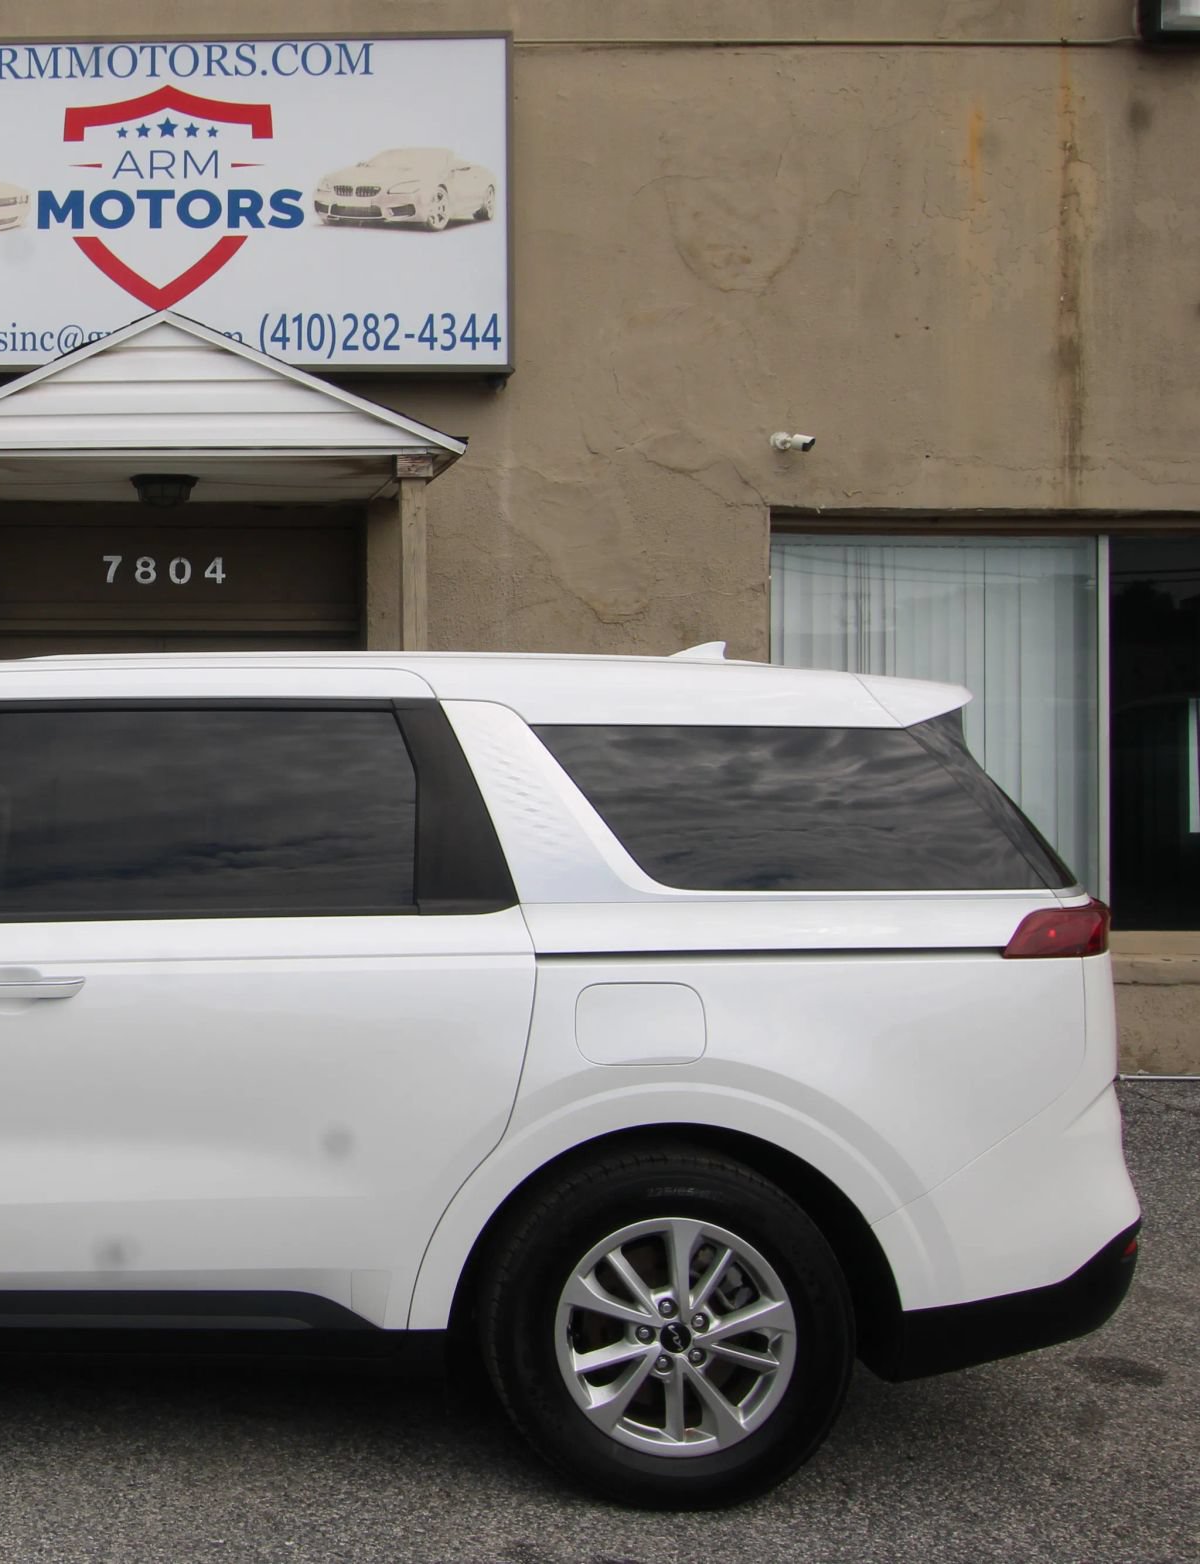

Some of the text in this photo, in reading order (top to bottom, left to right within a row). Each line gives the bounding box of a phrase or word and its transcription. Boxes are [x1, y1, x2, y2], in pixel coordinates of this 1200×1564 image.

[112, 149, 219, 179] ARM
[37, 188, 305, 230] MOTORS
[259, 313, 502, 359] (410)282-4344
[102, 555, 227, 585] 7804
